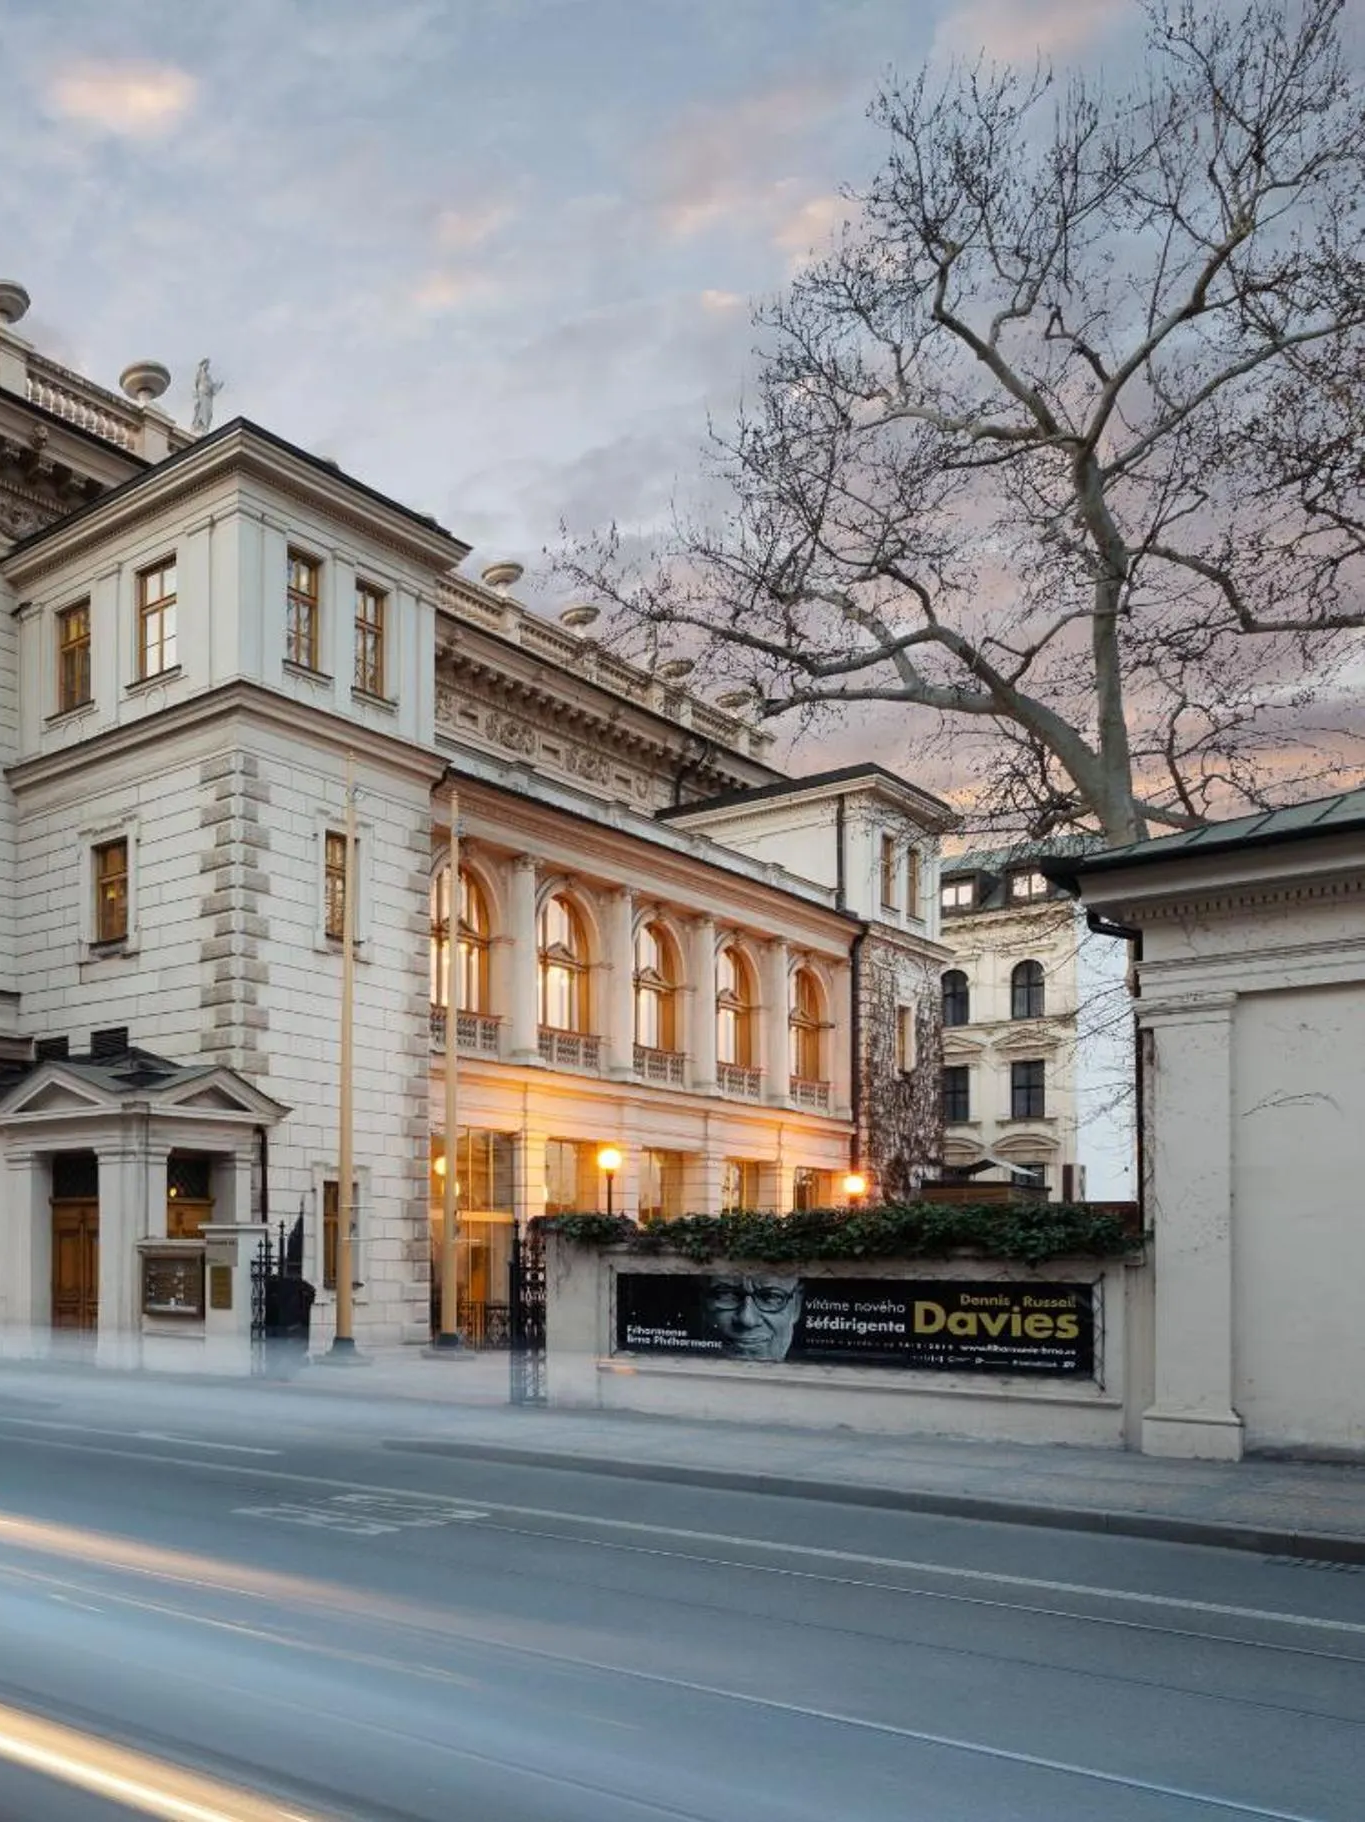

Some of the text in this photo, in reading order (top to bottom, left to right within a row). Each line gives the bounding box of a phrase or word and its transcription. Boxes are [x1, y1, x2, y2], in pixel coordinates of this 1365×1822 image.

[805, 1297, 906, 1313] vítáme nového
[959, 1293, 1077, 1309] Dennis Russell
[805, 1315, 906, 1335] šéfdirigenta
[913, 1301, 1080, 1339] Davies
